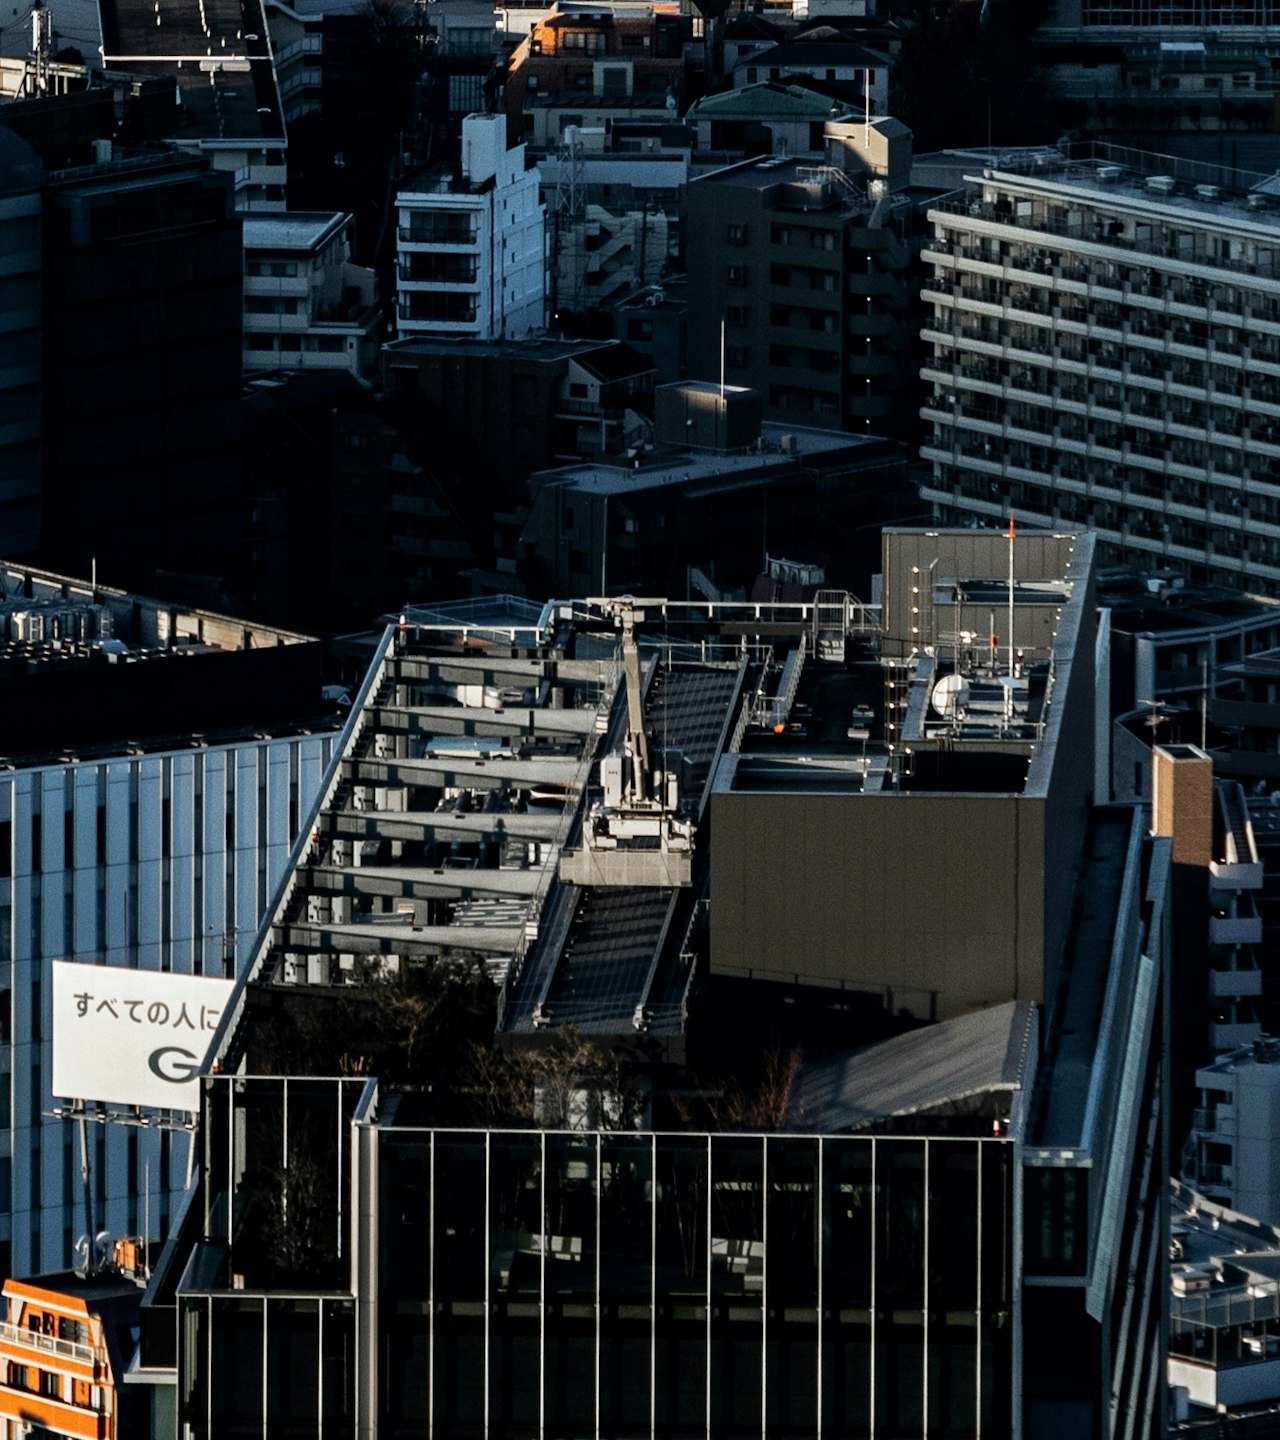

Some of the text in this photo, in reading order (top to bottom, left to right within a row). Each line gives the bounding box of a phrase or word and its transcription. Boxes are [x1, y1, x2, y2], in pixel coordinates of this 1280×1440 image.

[73, 992, 220, 1031] すべての人に
